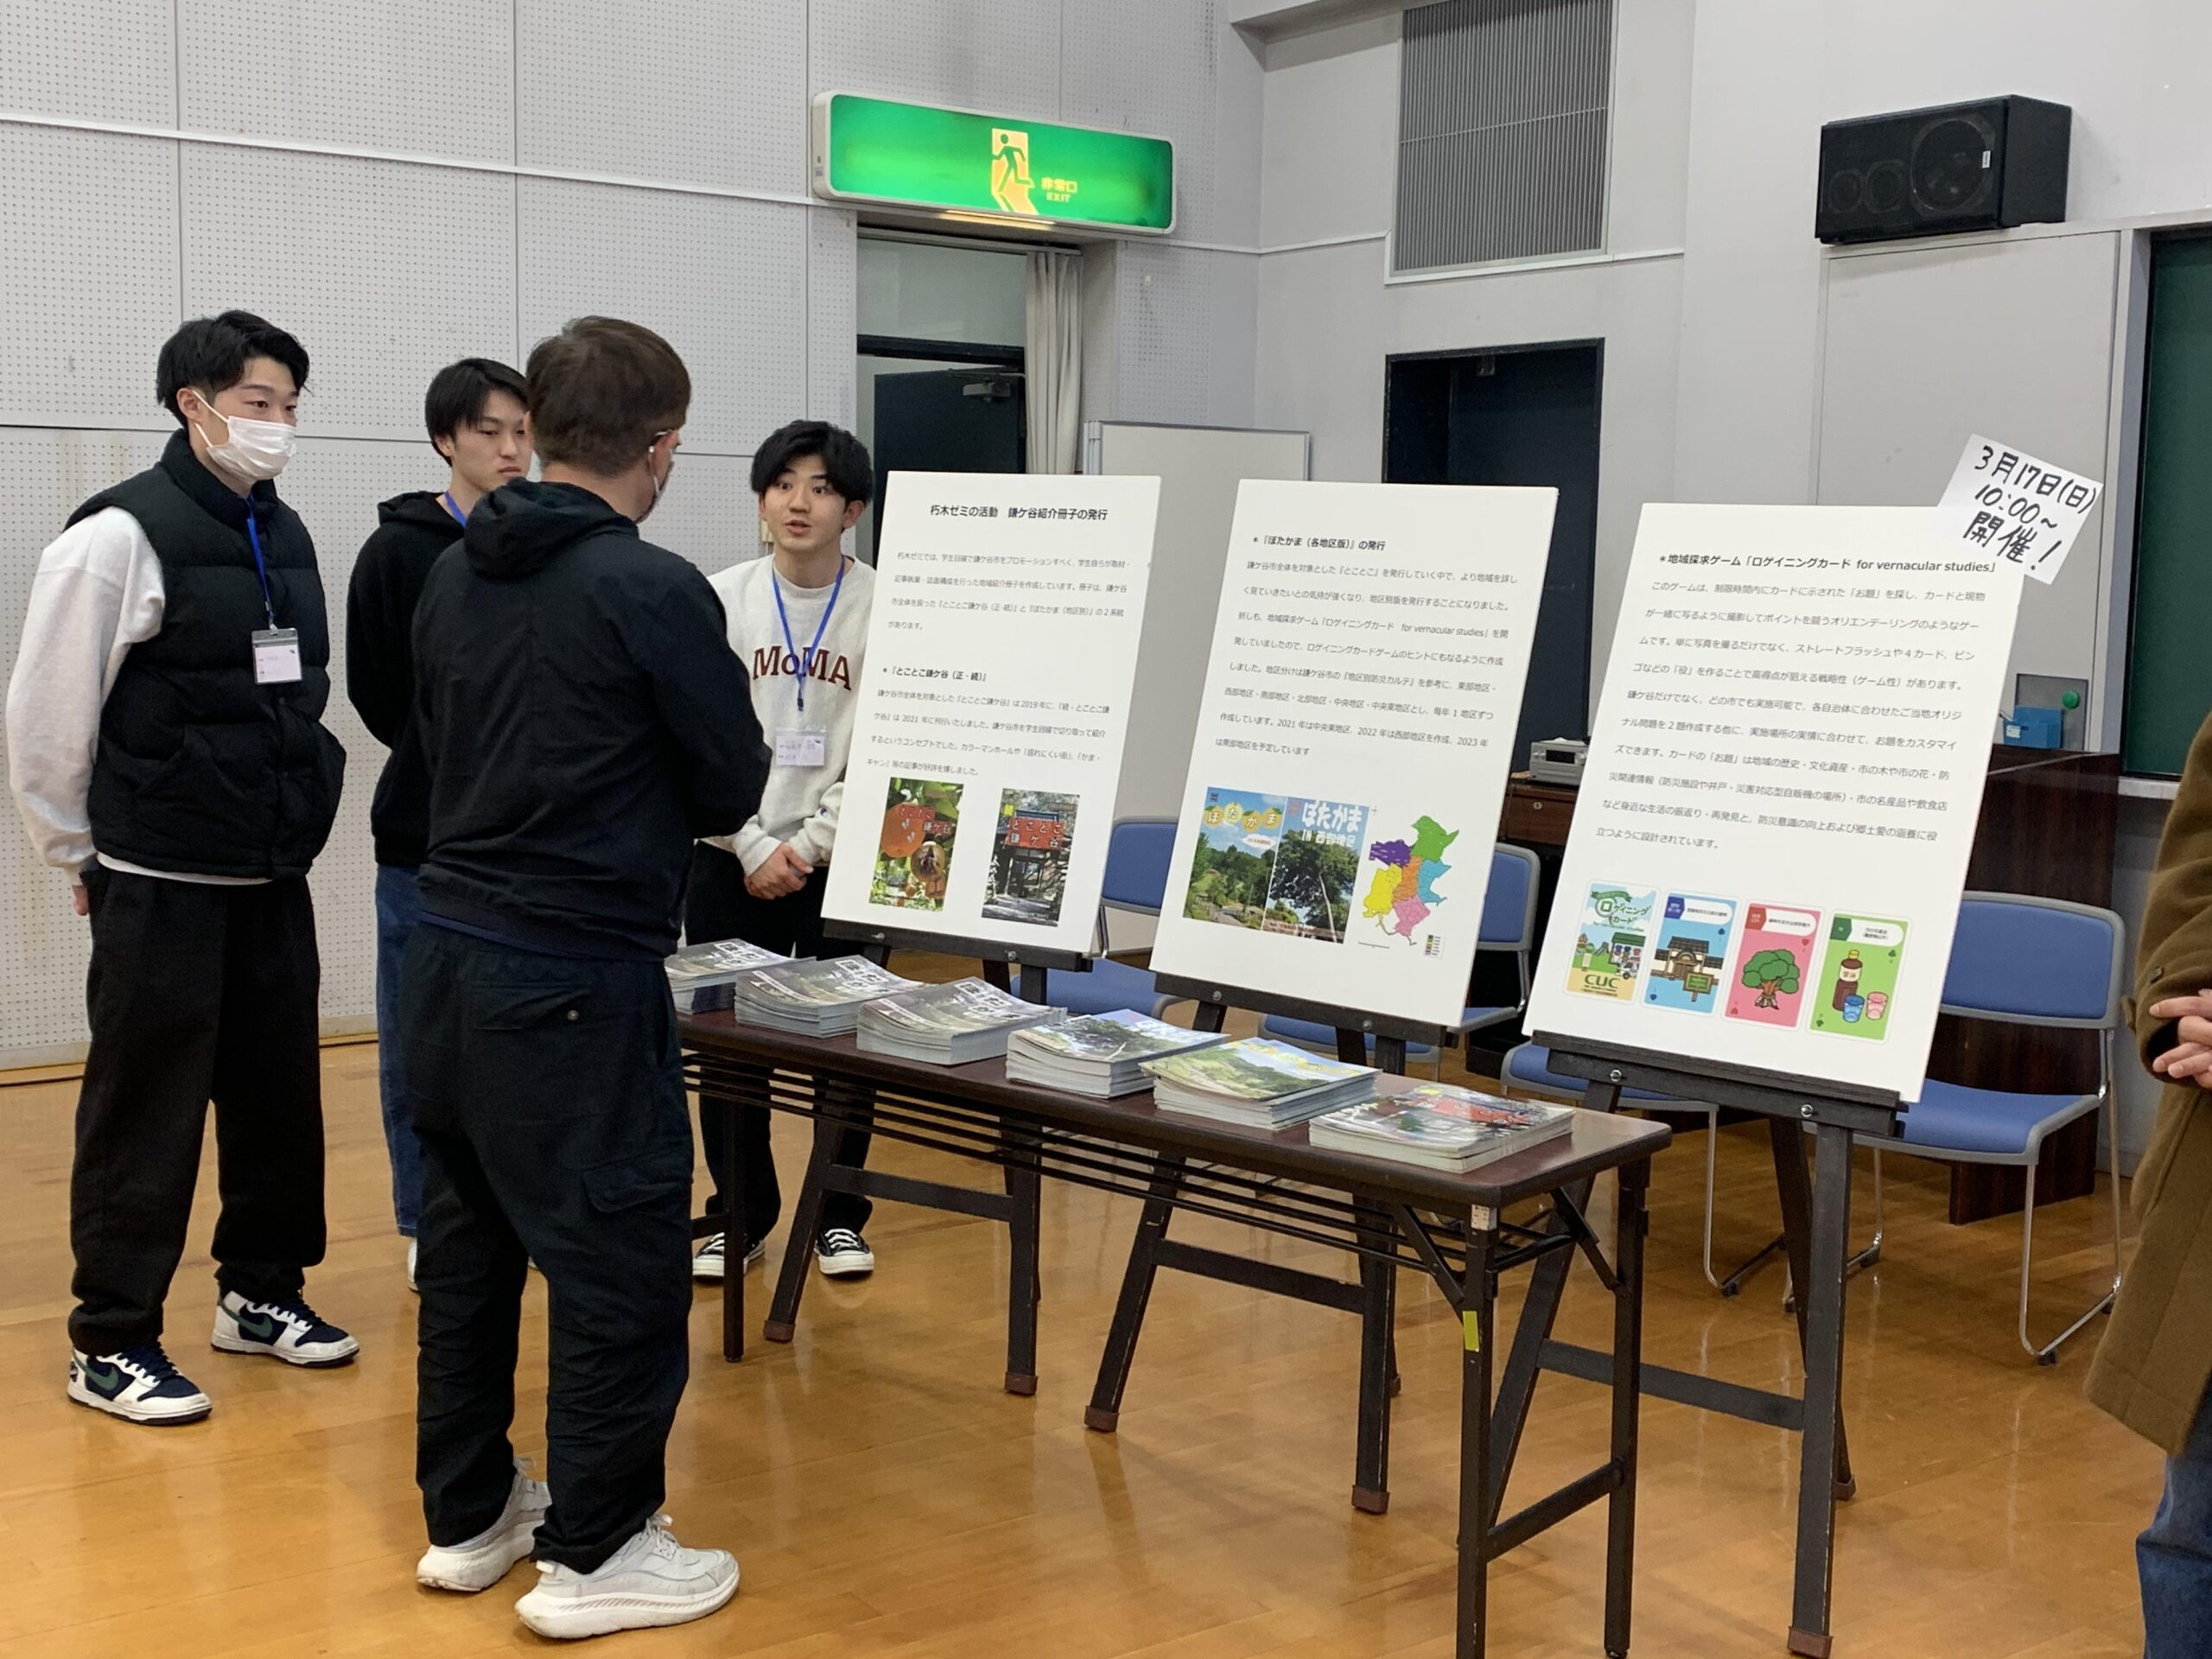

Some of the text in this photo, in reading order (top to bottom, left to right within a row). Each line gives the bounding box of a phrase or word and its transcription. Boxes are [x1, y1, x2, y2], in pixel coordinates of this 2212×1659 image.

[1041, 176, 1078, 193] 非常口
[1046, 192, 1071, 203] EXIT
[1974, 444, 2100, 515] 3月17日(日)
[930, 505, 998, 518] 朽木ゼミの活動
[1856, 559, 1874, 569] for
[1877, 561, 1942, 572] vernacular
[1414, 626, 1454, 637] vernacular
[753, 645, 852, 691] MoMA
[1012, 819, 1061, 835] とことこ
[1584, 974, 1621, 988] CUC
